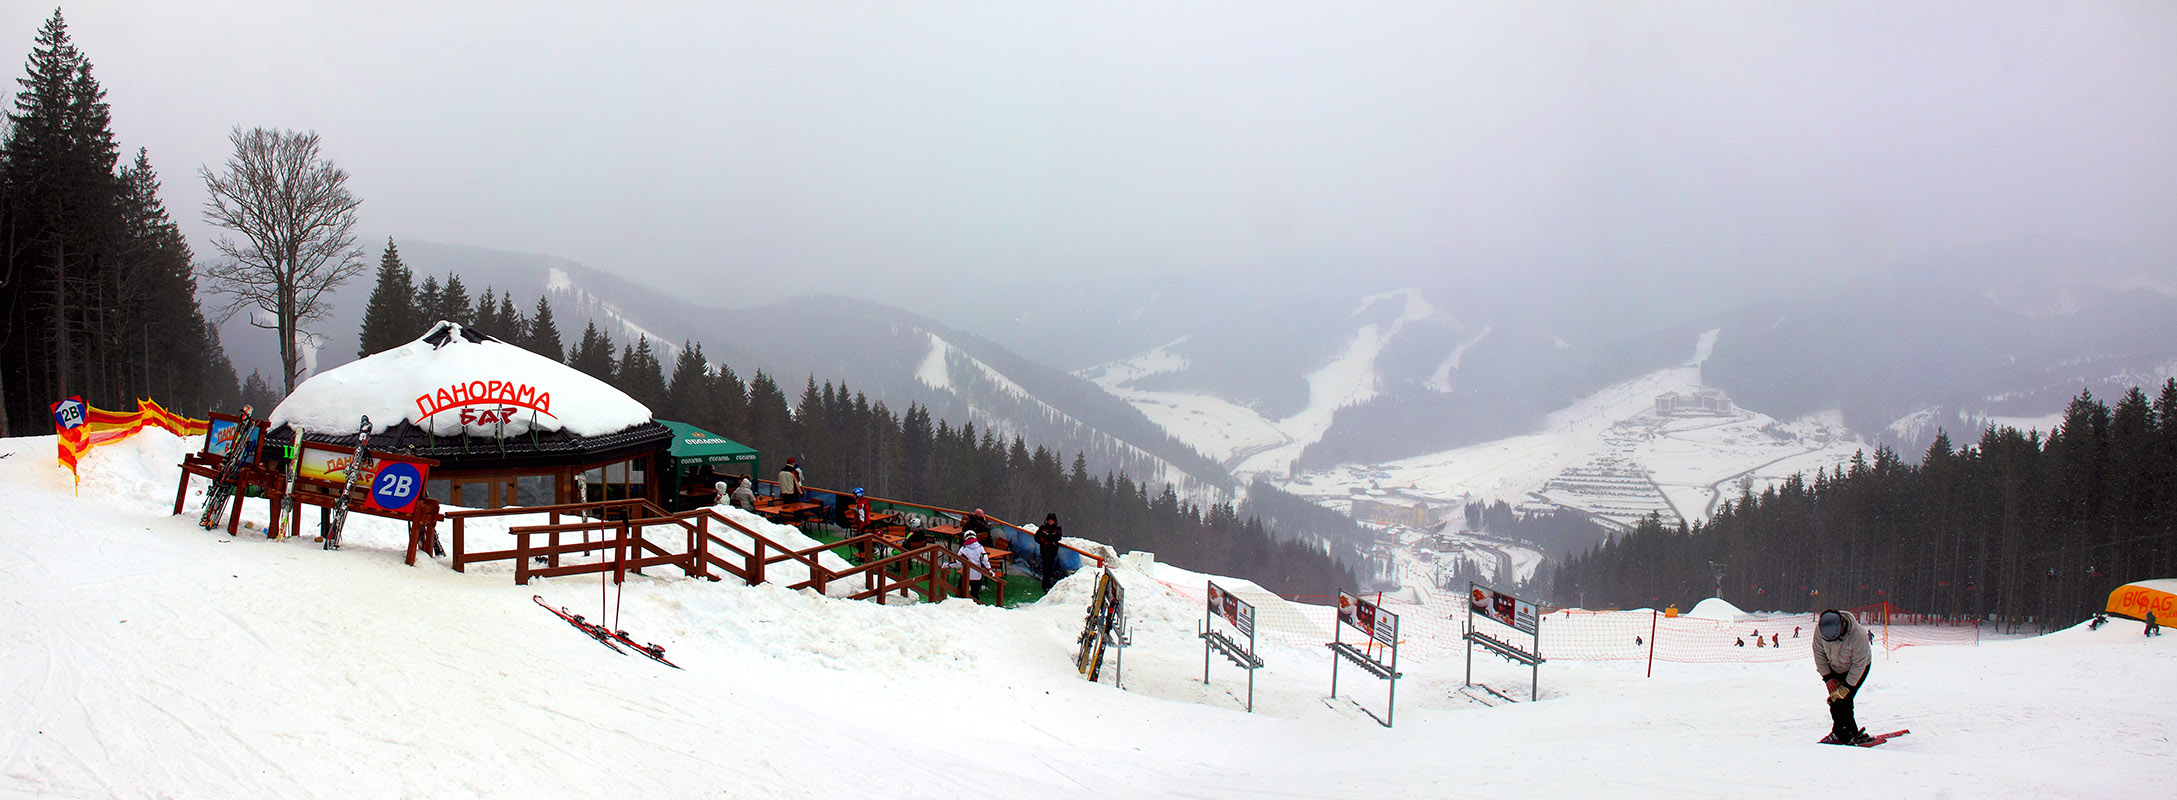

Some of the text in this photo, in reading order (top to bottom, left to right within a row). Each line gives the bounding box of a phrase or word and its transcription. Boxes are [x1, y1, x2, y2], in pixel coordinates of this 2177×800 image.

[415, 380, 551, 418] ПАНОРАМА
[61, 405, 80, 422] 2B
[459, 407, 518, 427] БАР
[378, 473, 413, 498] 2B
